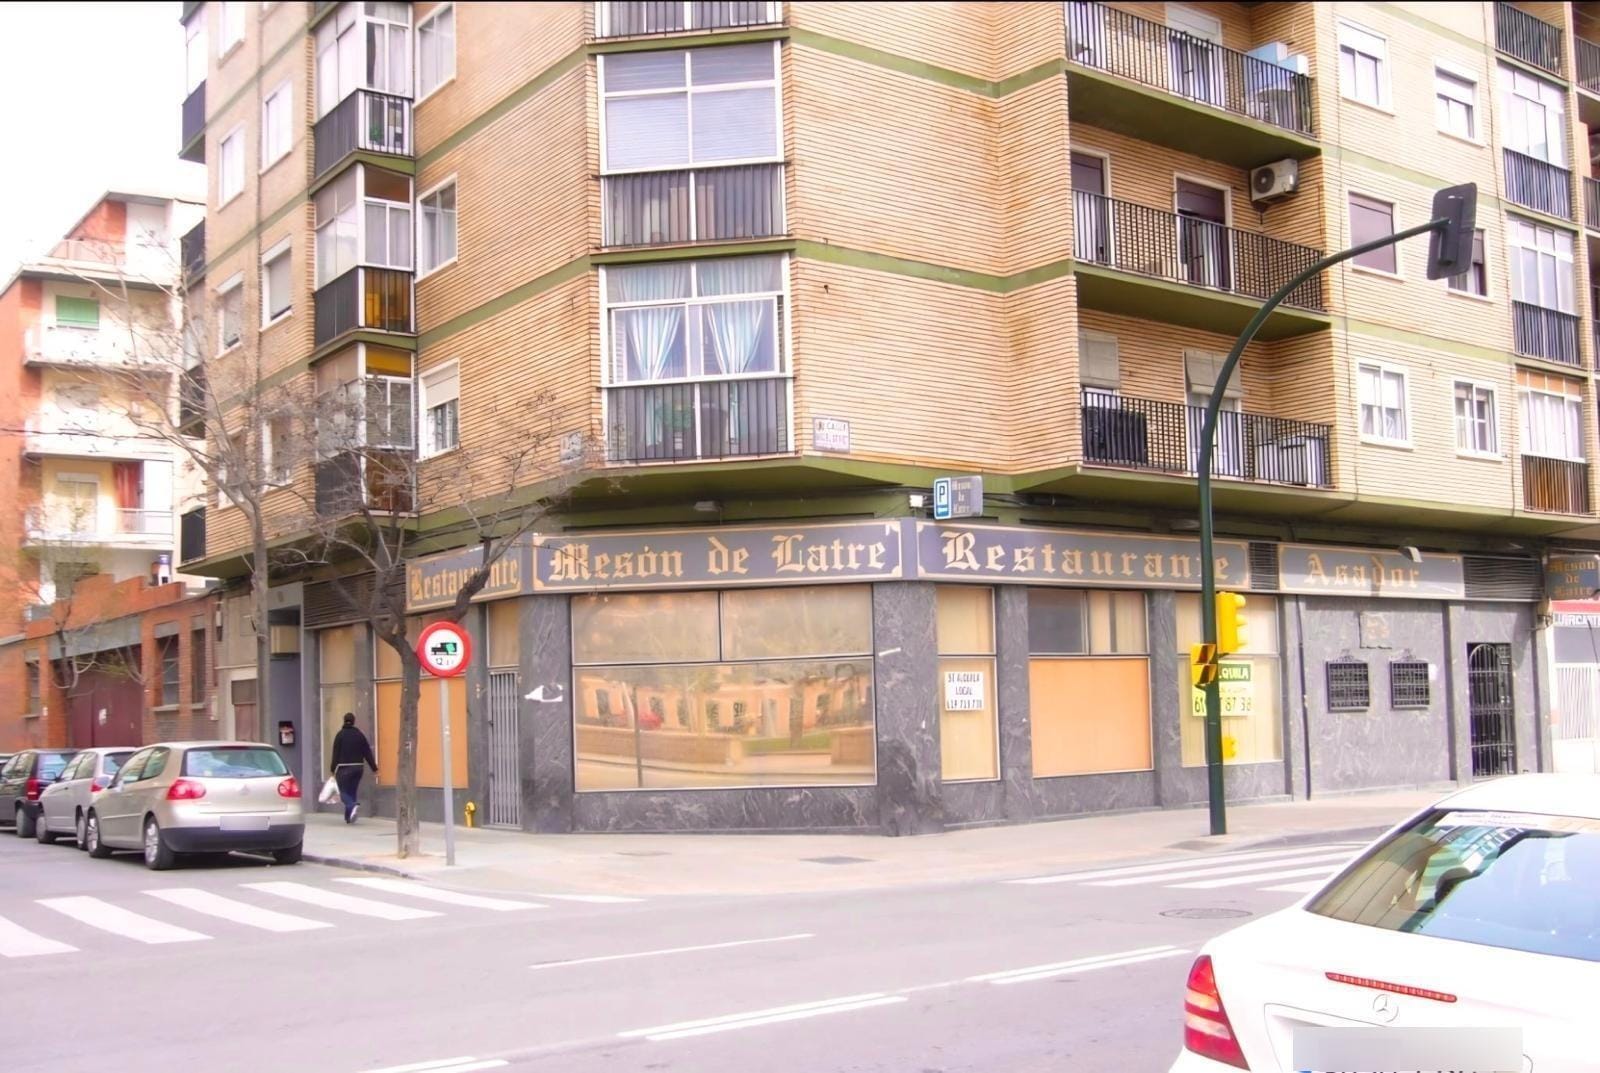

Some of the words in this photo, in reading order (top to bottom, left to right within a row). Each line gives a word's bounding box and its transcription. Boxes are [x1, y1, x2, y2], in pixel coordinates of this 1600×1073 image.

[707, 536, 749, 575] de
[771, 533, 886, 573] Latre
[940, 531, 1229, 580] Restaurane
[1304, 553, 1419, 588] Asador
[411, 558, 519, 600] Restaunte
